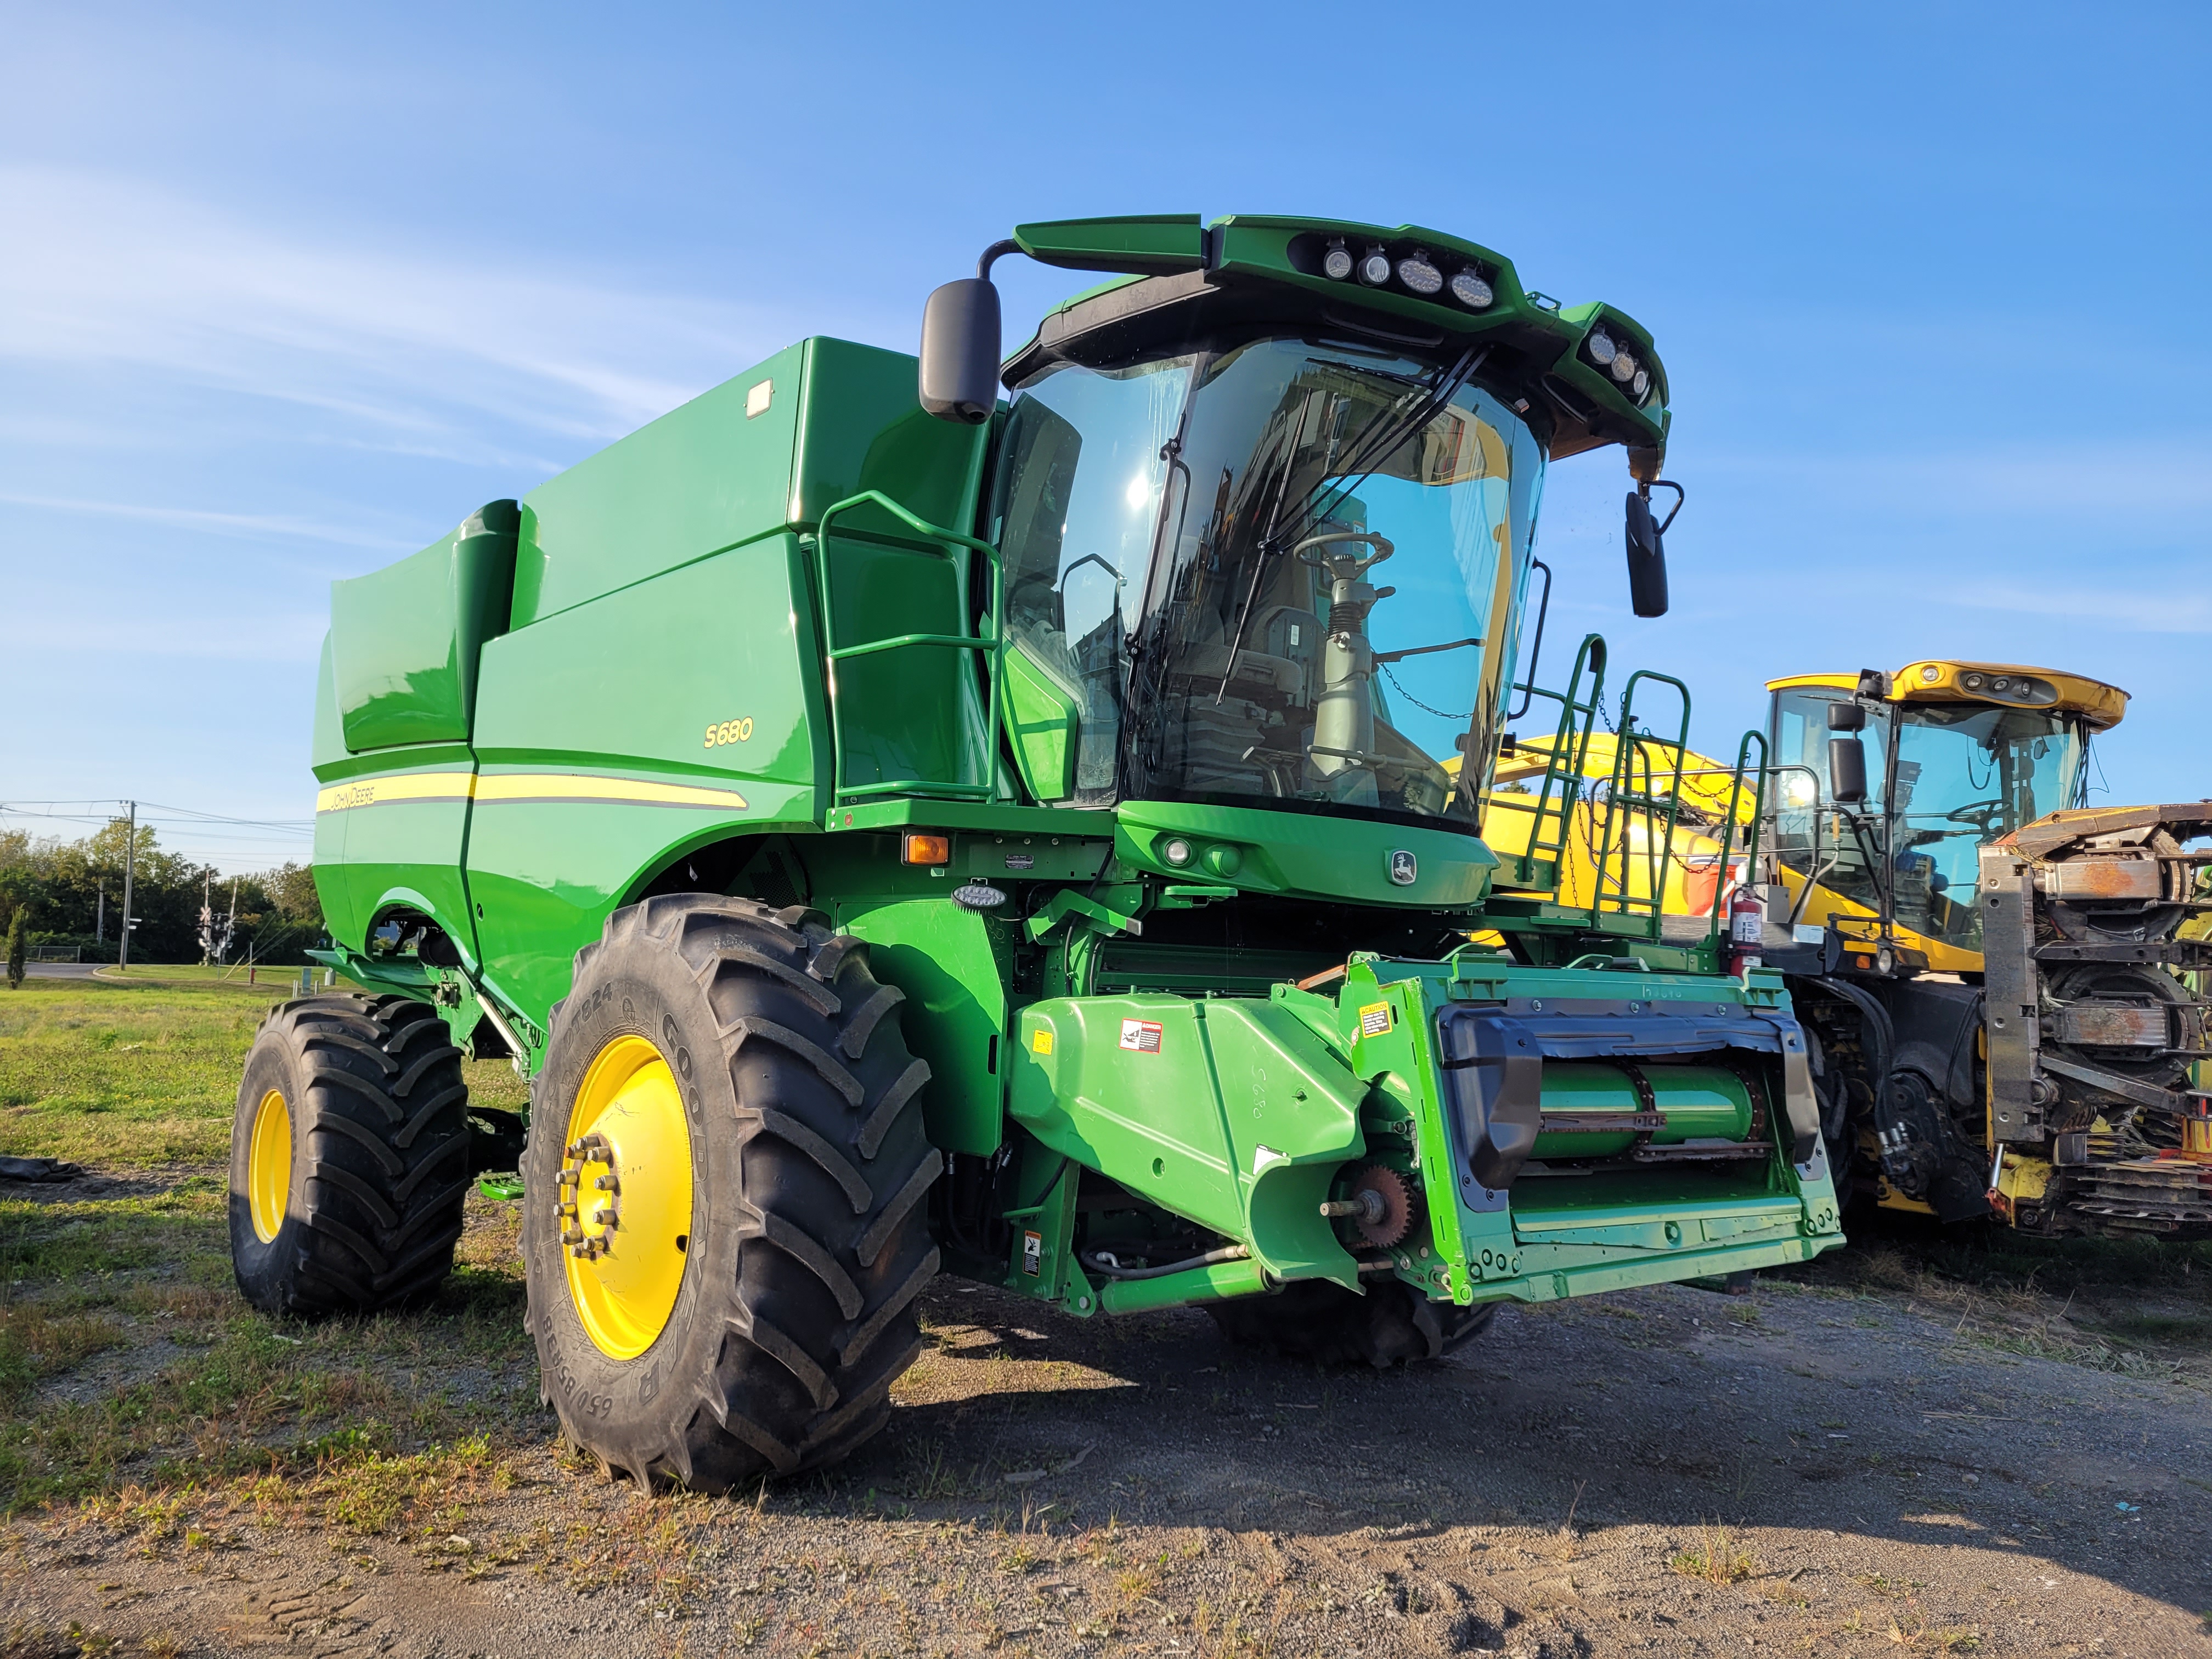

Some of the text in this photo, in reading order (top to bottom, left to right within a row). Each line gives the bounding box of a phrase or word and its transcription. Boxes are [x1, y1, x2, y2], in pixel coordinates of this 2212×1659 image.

[704, 716, 753, 749] S680
[331, 787, 375, 809] JOHN DEERE
[563, 981, 613, 1056] DT824
[1365, 1003, 1387, 1013] CAUTION
[638, 1013, 710, 1407] GOODYEAR
[543, 1314, 613, 1420] 650/85R38
